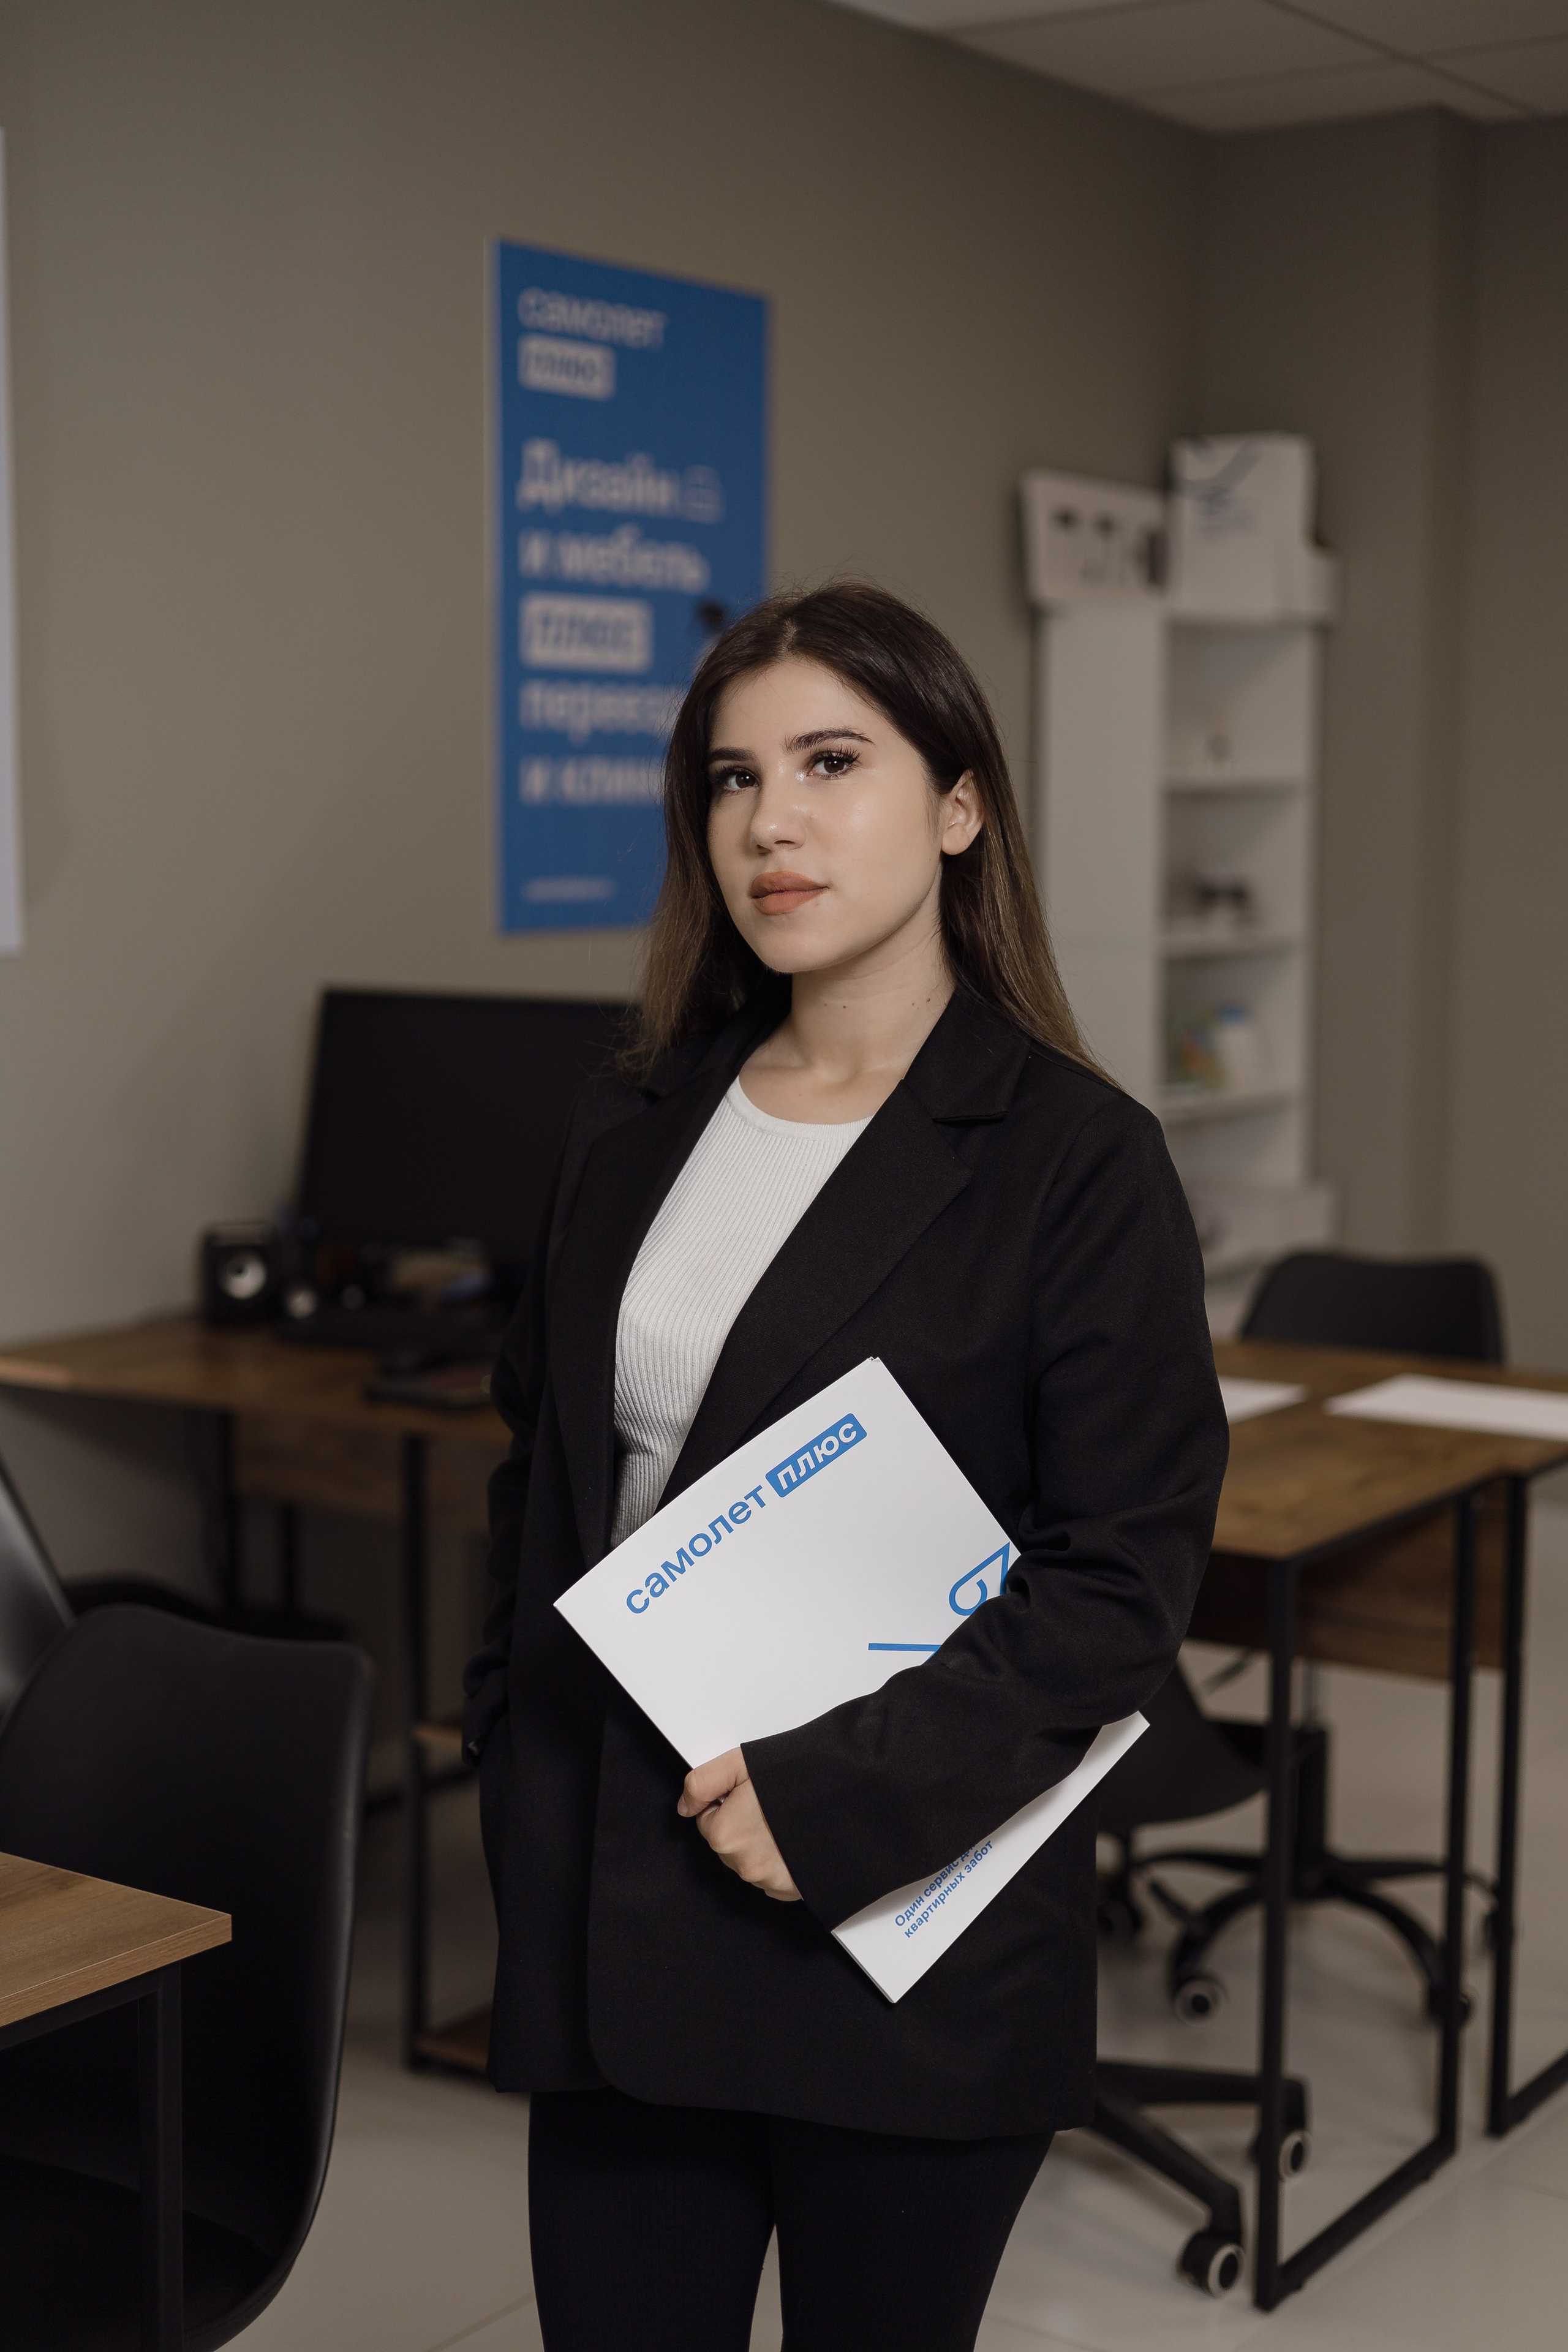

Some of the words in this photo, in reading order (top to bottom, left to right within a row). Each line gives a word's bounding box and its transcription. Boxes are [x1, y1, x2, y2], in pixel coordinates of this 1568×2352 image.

[518, 287, 668, 349] самолет
[518, 439, 677, 515] Дизайн
[521, 530, 550, 577] и
[557, 524, 709, 592] мебель
[521, 758, 550, 803] и
[556, 757, 665, 804] клин
[625, 1483, 768, 1615] самолет
[775, 1421, 859, 1491] плюс
[894, 1895, 924, 1928] Один
[923, 1860, 960, 1898] сервис
[904, 1872, 966, 1939] квартирных
[965, 1841, 994, 1874] забот
